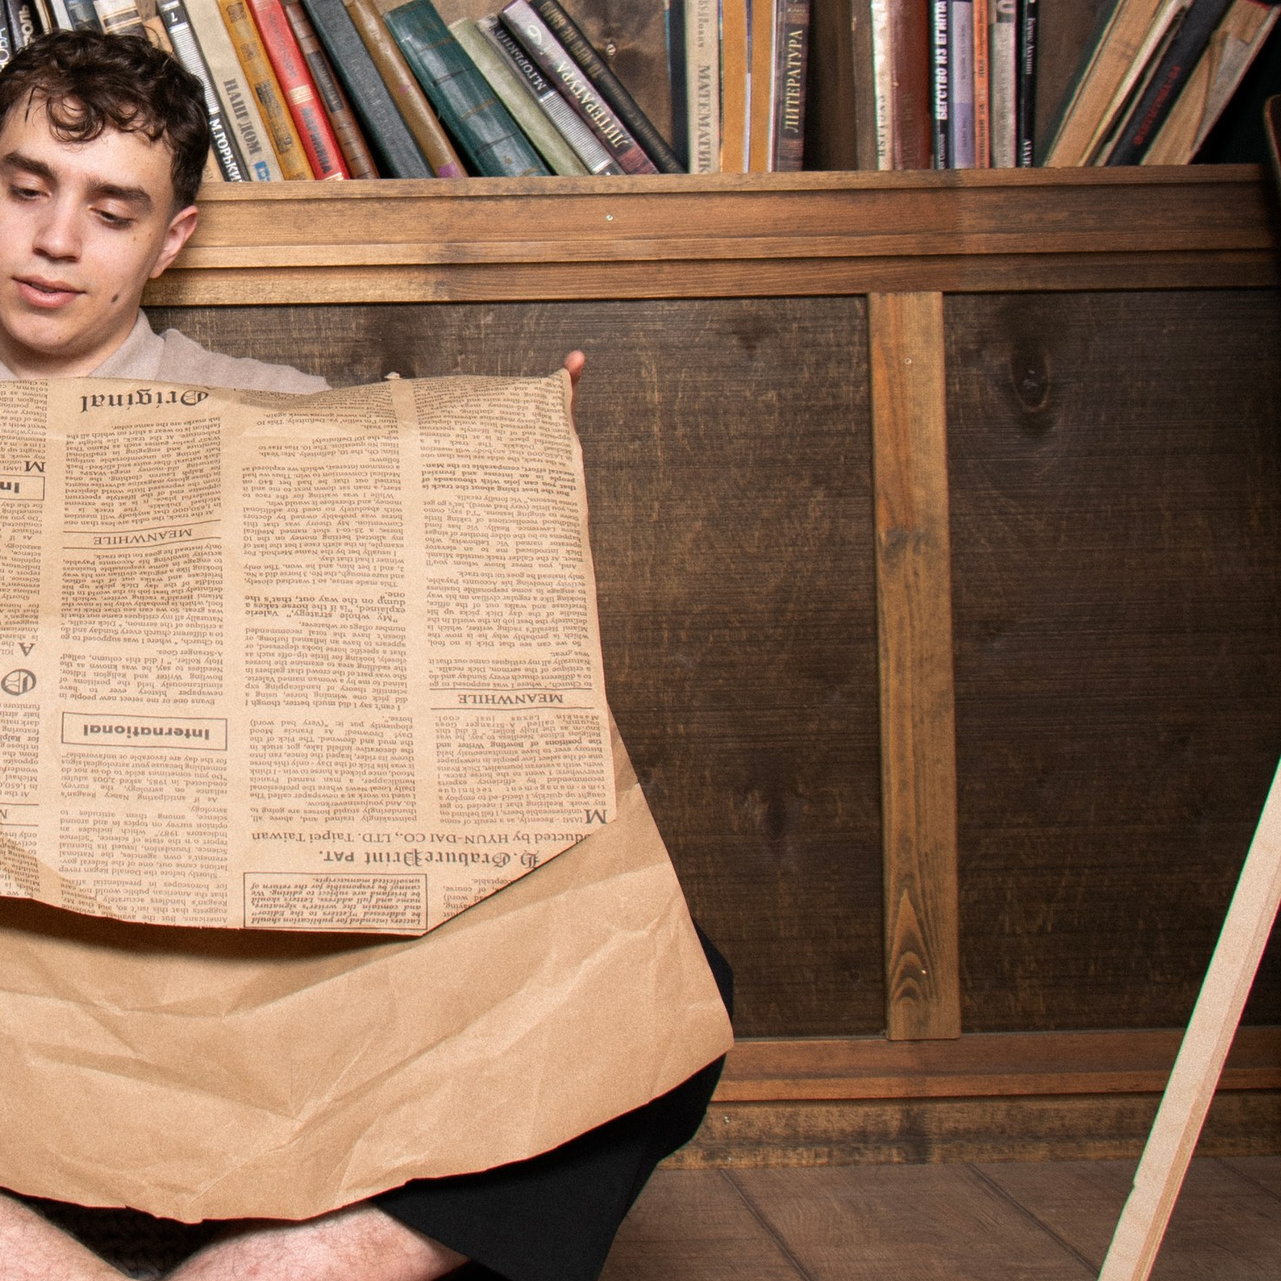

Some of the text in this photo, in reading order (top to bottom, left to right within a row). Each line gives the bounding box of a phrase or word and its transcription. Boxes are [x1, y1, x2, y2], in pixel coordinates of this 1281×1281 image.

[934, 46, 947, 65] ИЗ
[784, 28, 806, 131] ЛИТЕРАТУРА
[935, 65, 949, 120] БЕГСТВО
[551, 61, 626, 150] ЛИТЕРАТУРА
[221, 77, 266, 156] НАШ ДОМ
[80, 387, 209, 412] Original
[93, 528, 193, 546] MEANWHILE
[286, 610, 332, 618] strategy,"
[340, 612, 369, 620] whole
[377, 613, 398, 622] "My
[457, 693, 563, 704] MEANWHILE
[83, 724, 210, 741] International
[251, 832, 305, 843] Taiwan
[309, 830, 354, 844] Taipei
[358, 832, 391, 844] LTD.
[394, 831, 427, 844] CO.,
[430, 832, 509, 844] HYUN-DAI
[512, 830, 531, 845] by
[318, 850, 355, 863] PAT.
[283, 916, 334, 924] publication
[351, 917, 388, 925] intended
